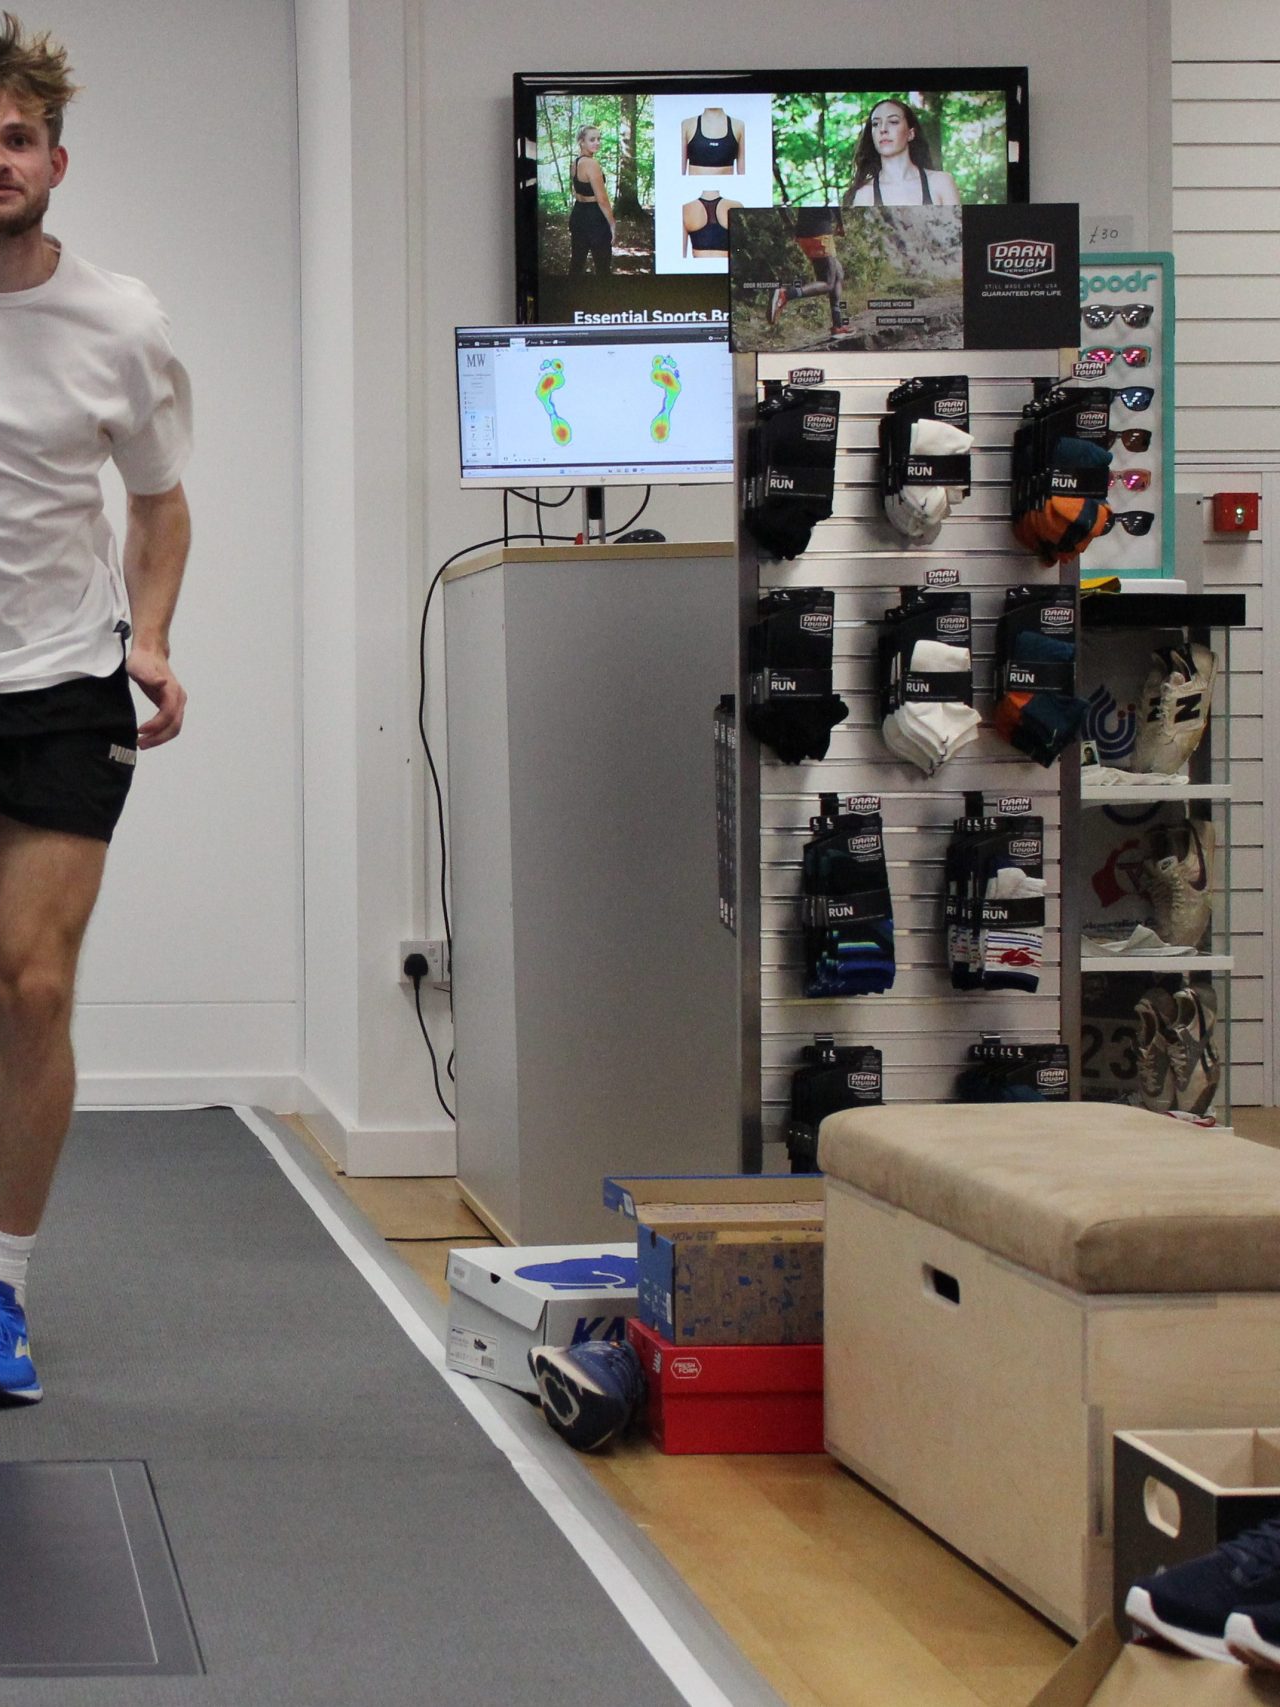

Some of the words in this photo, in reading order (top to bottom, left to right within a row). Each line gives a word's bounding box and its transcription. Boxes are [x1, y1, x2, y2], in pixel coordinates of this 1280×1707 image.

[1089, 225, 1119, 245] £30
[995, 245, 1049, 258] DARN
[994, 258, 1047, 268] TOUGH
[1079, 270, 1158, 302] goodr
[574, 309, 648, 325] Essential
[652, 309, 707, 323] Sports
[466, 353, 487, 368] MW
[1075, 362, 1104, 370] DARN
[792, 369, 821, 377] DARN
[907, 466, 932, 476] RUN
[769, 479, 794, 489] RUN
[1051, 477, 1077, 488] RUN
[1009, 672, 1035, 683] RUN
[771, 681, 796, 691] RUN
[906, 682, 929, 693] RUN
[1174, 693, 1202, 724] N
[828, 906, 854, 917] RUN
[982, 910, 1008, 919] RUN
